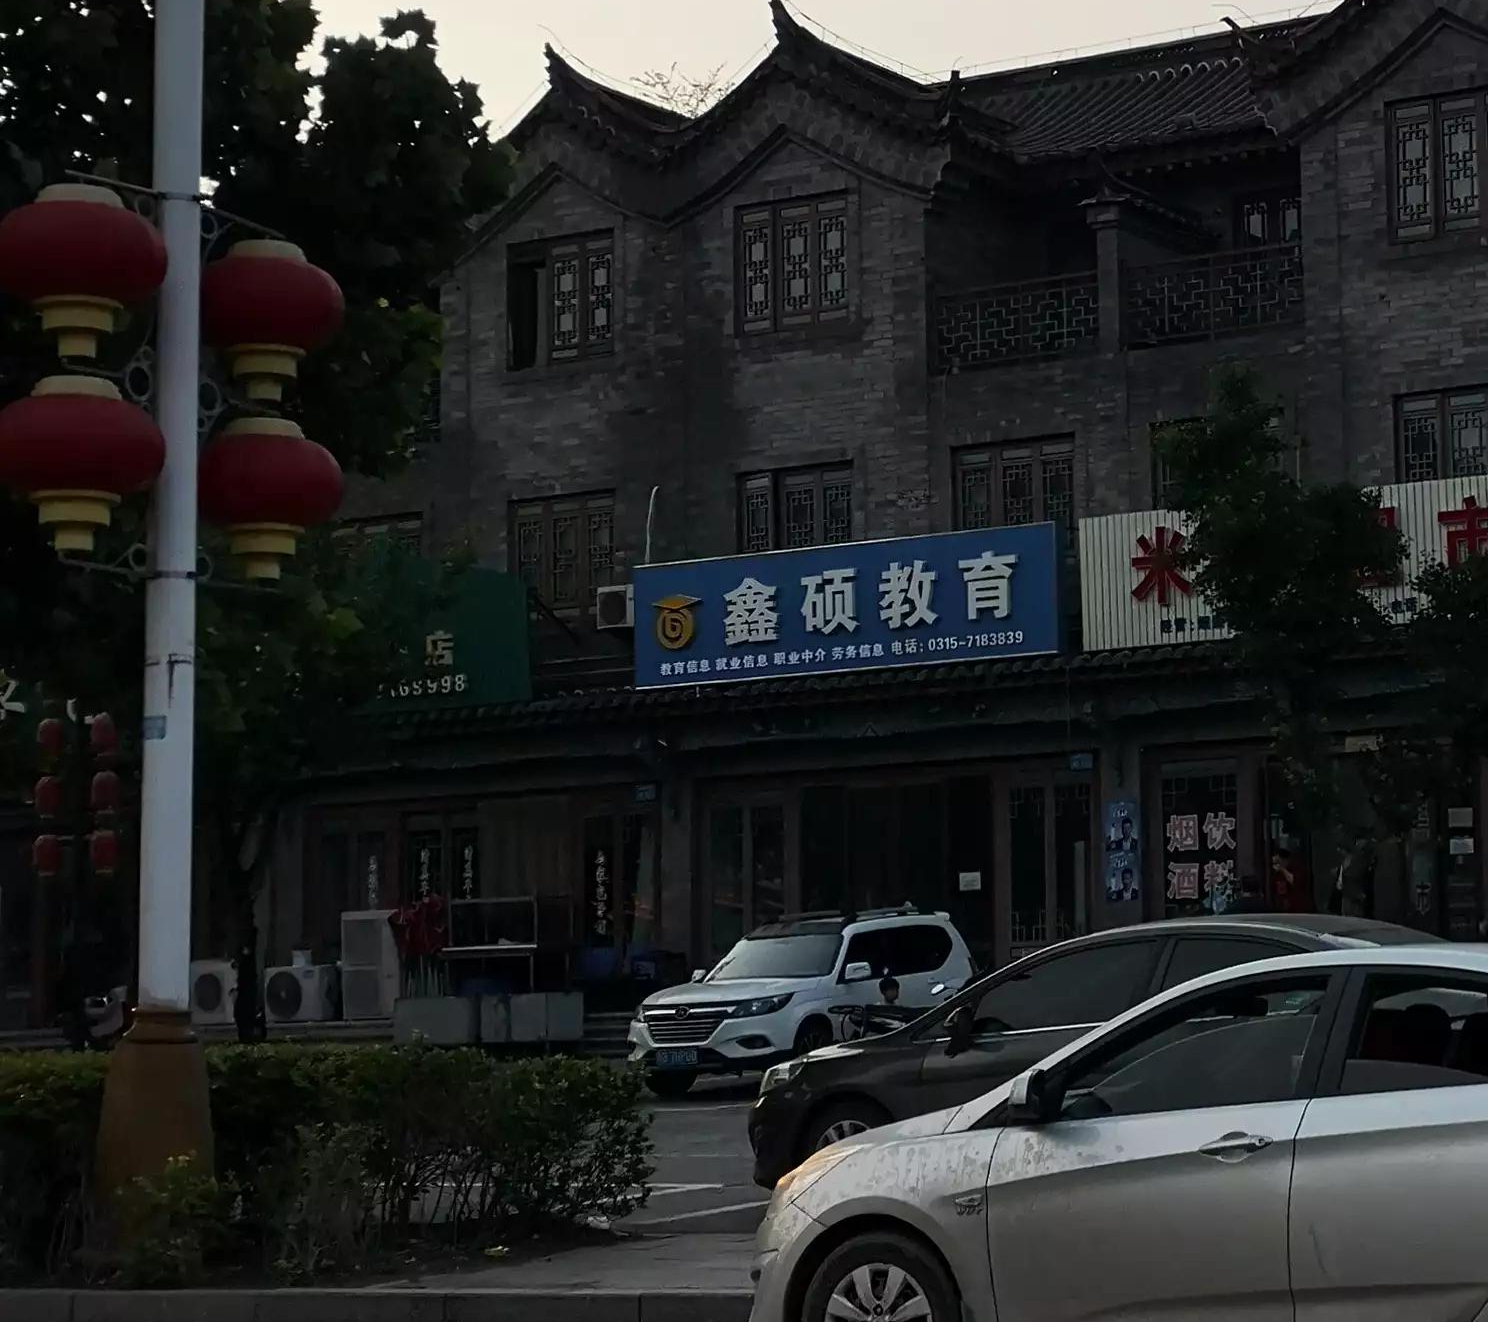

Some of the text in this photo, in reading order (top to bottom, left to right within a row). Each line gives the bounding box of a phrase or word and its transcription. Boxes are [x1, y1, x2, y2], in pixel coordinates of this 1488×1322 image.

[723, 551, 1018, 646] 鑫硕教育
[425, 630, 454, 666] 店
[660, 659, 711, 676] 教育信息
[715, 654, 768, 671] 就业信息
[774, 648, 827, 666] 职业中介
[831, 642, 885, 661] 劳务信息
